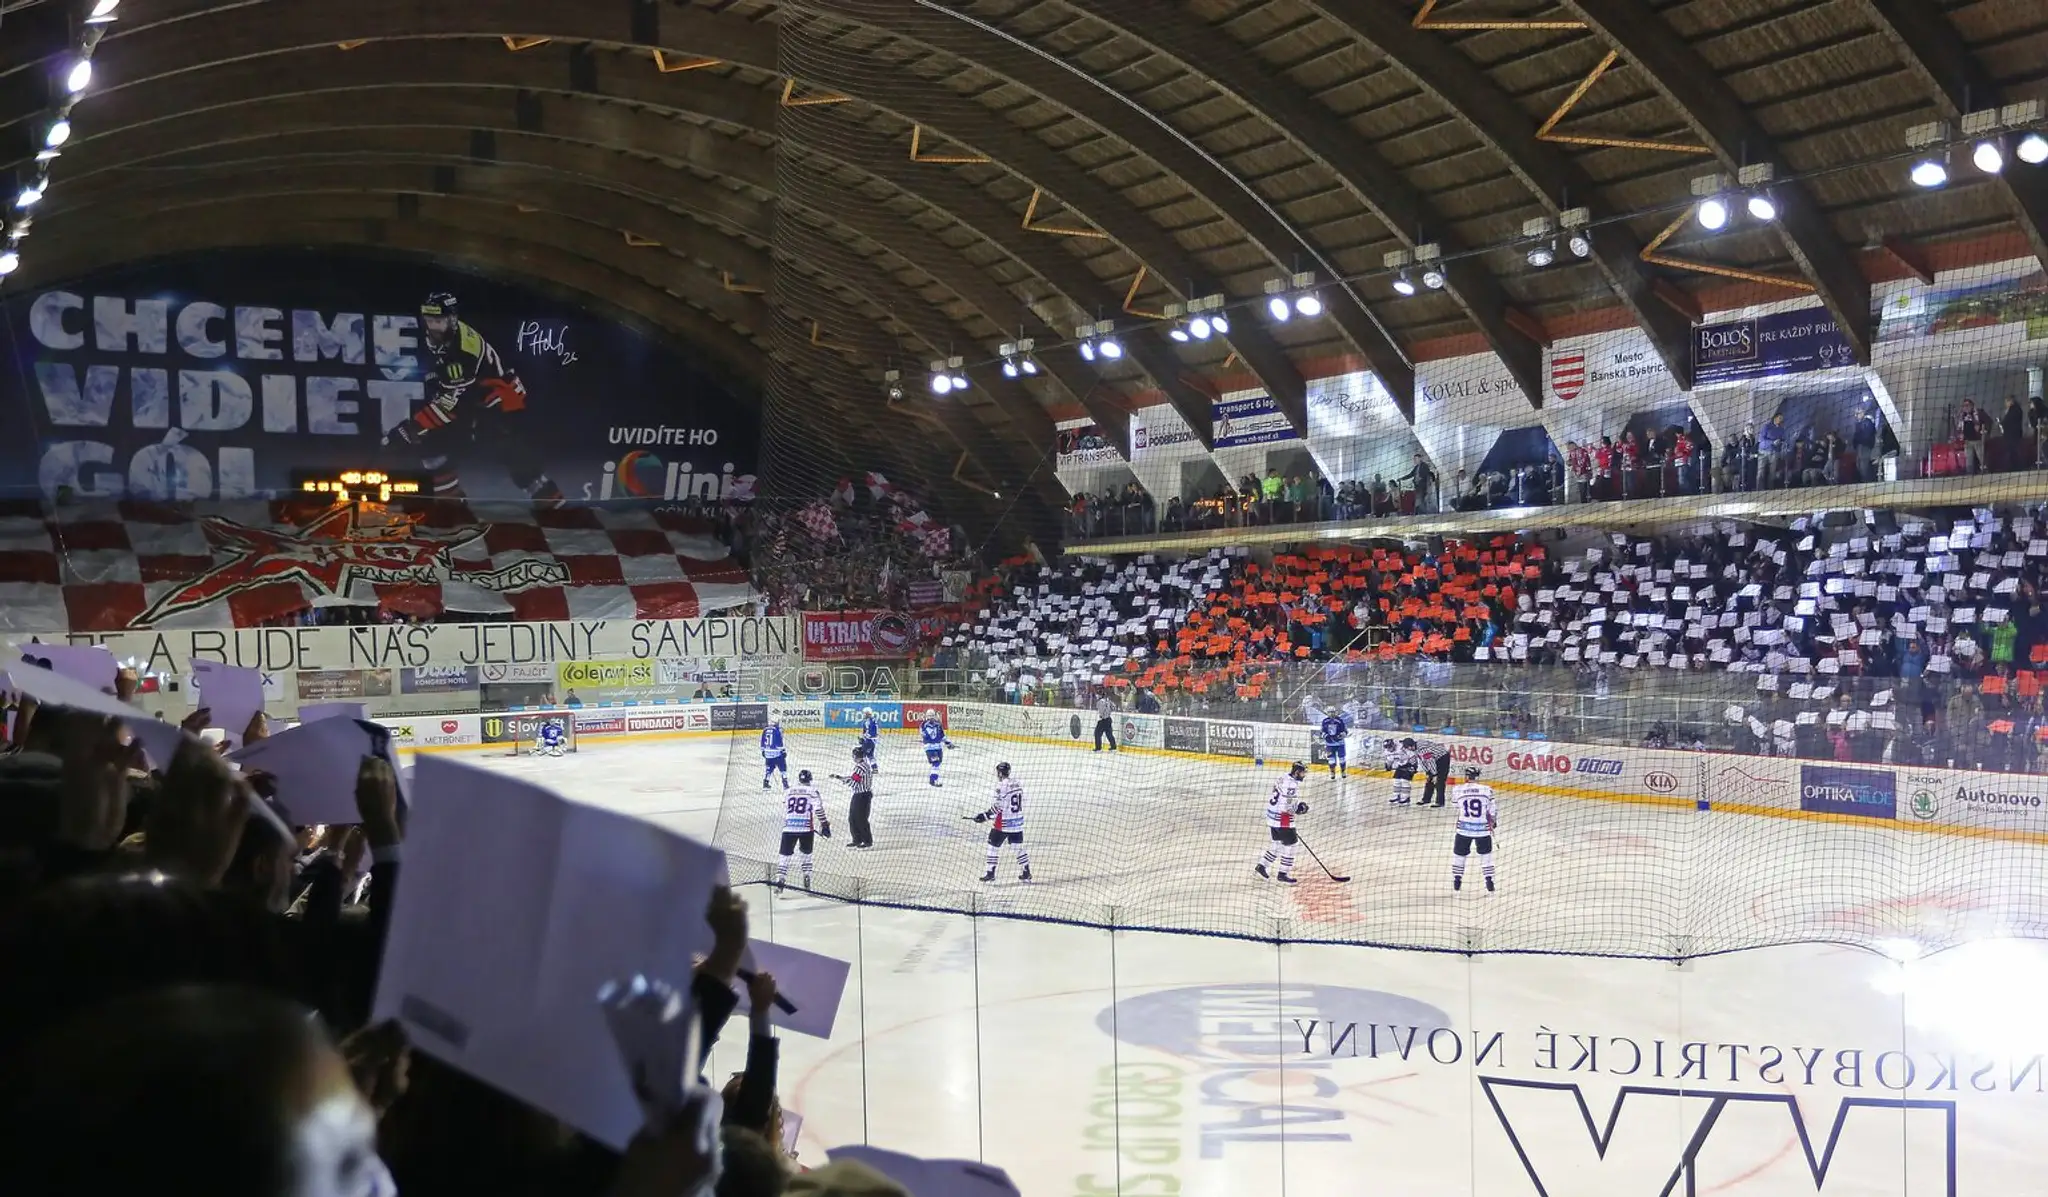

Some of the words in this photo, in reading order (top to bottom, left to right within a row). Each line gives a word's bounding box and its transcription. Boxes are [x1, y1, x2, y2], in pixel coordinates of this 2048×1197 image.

[29, 290, 419, 367] CHCEME
[1760, 331, 1776, 342] PRE
[1614, 353, 1644, 364] Mesto
[34, 362, 425, 436] VIDIEŤ
[1422, 380, 1473, 402] KOVAL
[1478, 378, 1489, 394] &
[1219, 401, 1254, 414] transport
[609, 424, 685, 445] UVIDÍTE
[689, 428, 718, 445] HO
[39, 427, 277, 501] GÓL
[807, 620, 872, 645] ULTRAS
[145, 632, 178, 674] A
[192, 628, 322, 671] BUDE
[350, 625, 438, 669] NÁŠ
[458, 620, 606, 664] JEDINÝ
[631, 617, 800, 659] ŠAMPIÓN!
[782, 708, 820, 717] SUZUKI
[843, 707, 899, 723] Tipport
[948, 705, 963, 715] BDM
[629, 718, 674, 730] TONDACH
[1209, 724, 1254, 740] ELKOND
[1449, 744, 1493, 765] ABAG
[1506, 751, 1572, 774] GAMO
[1650, 775, 1673, 788] KIA
[1955, 787, 2041, 807] Autonovo
[1463, 799, 1482, 818] 19
[1198, 987, 1353, 1161] MEDICAL
